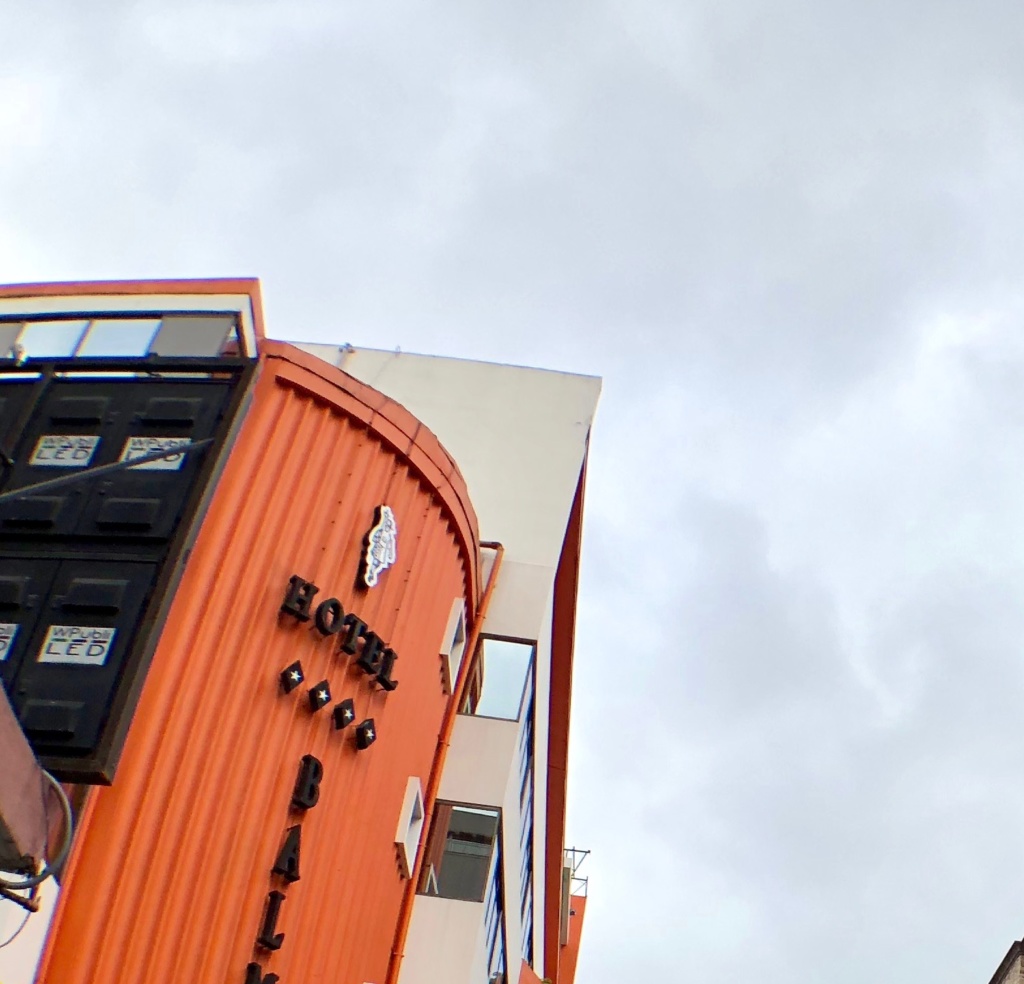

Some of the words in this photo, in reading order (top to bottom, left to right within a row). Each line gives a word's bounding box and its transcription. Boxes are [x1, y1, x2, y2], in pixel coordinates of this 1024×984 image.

[36, 449, 90, 461] LED
[278, 574, 399, 692] HOTEL
[46, 642, 106, 657] LED
